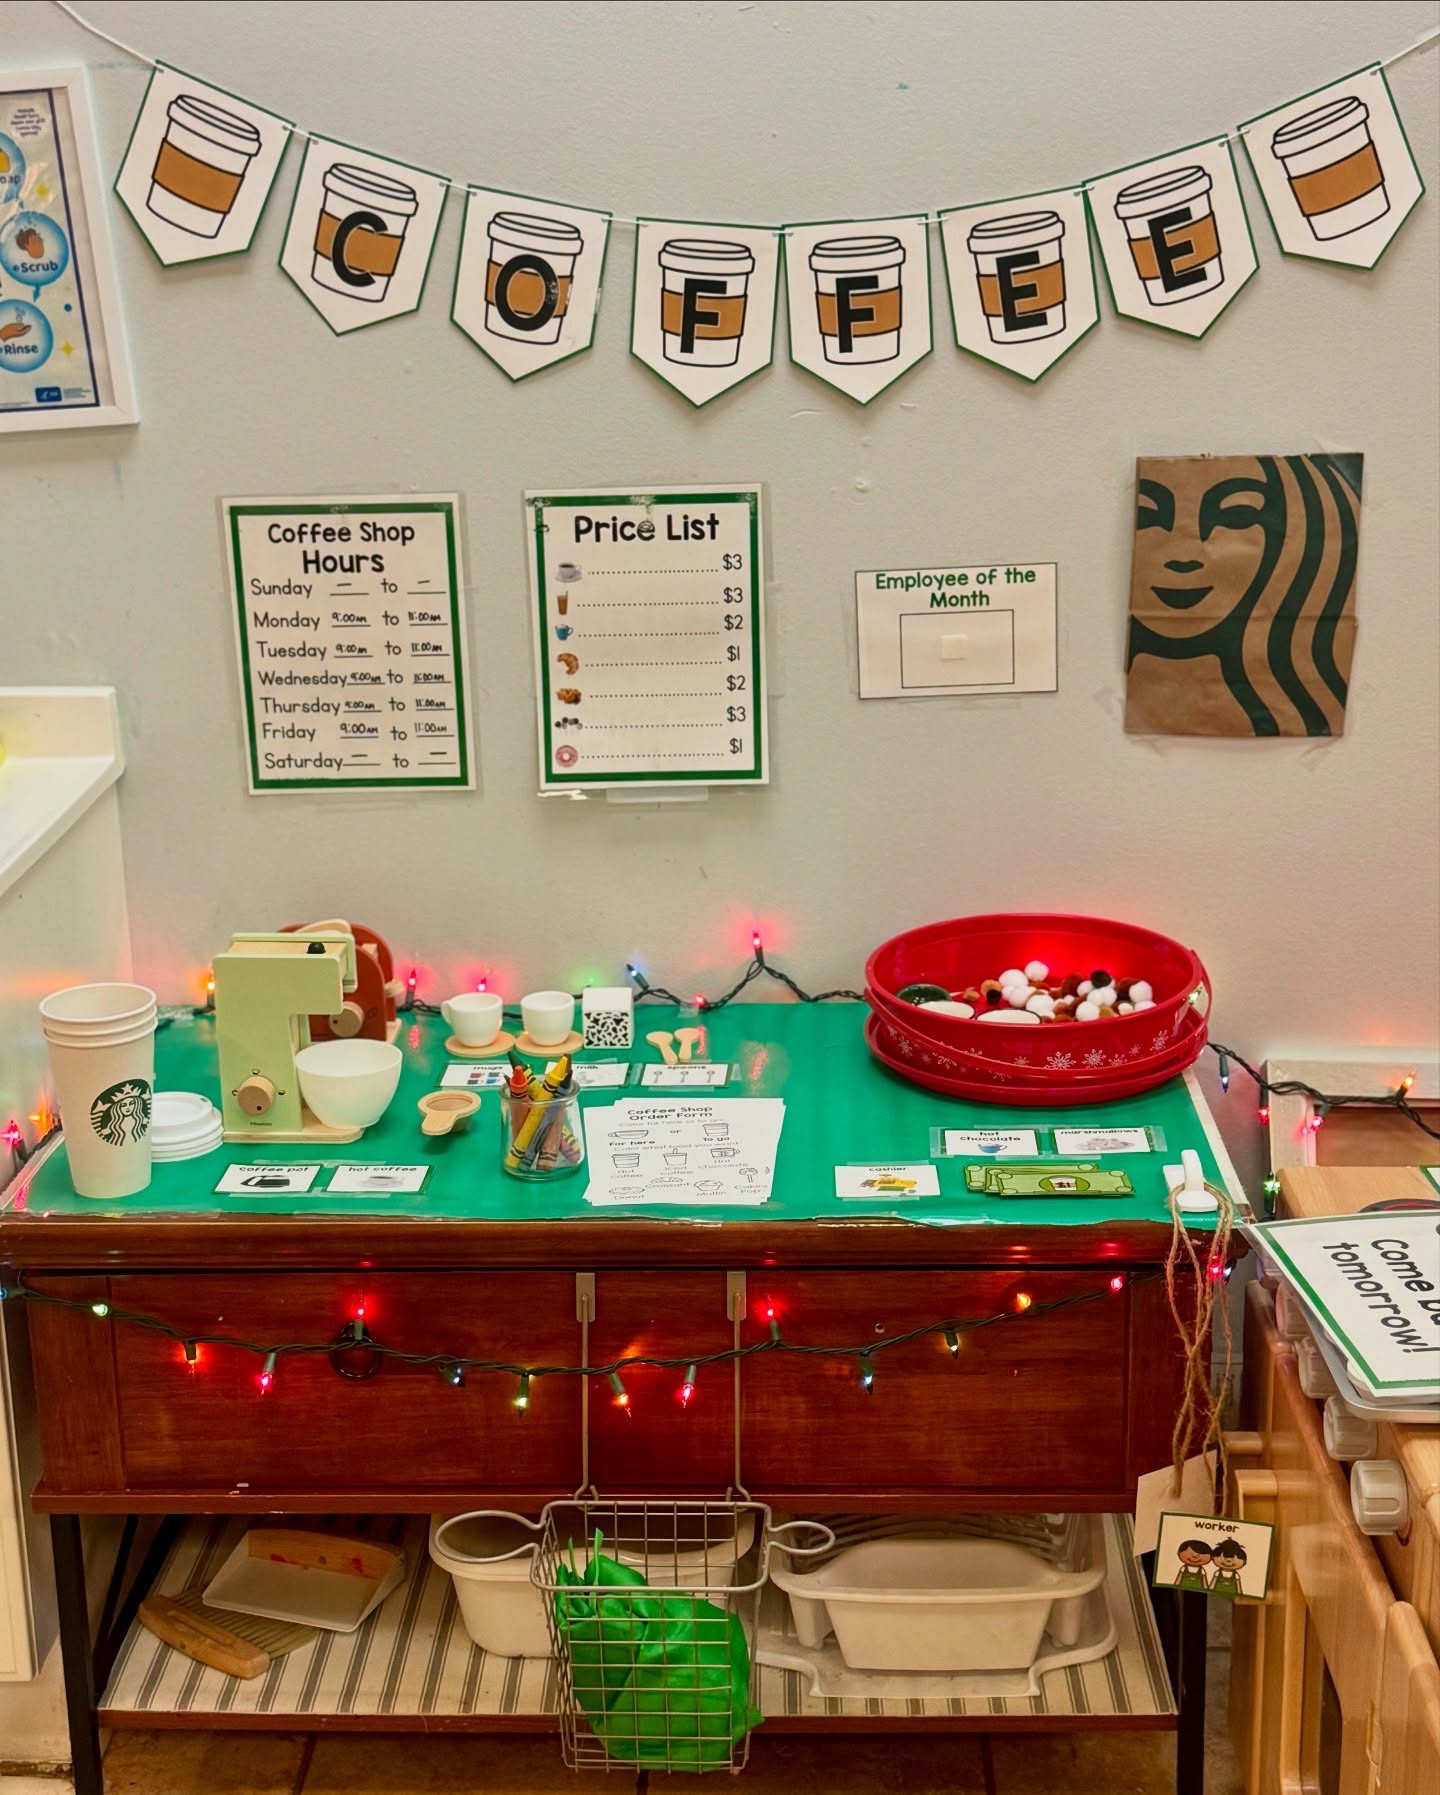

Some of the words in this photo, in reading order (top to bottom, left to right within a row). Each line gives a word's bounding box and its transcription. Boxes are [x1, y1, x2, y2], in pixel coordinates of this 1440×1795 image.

[20, 260, 59, 273] Scrub
[4, 344, 39, 355] Rinse
[267, 522, 352, 544] Coffee
[359, 521, 415, 546] Shop
[573, 515, 656, 543] Price
[666, 513, 720, 541] List
[302, 549, 385, 574] Hours
[722, 553, 743, 571] $3
[250, 578, 313, 599] Sunday
[381, 578, 398, 593] to
[875, 572, 969, 592] Employee
[976, 568, 998, 585] of
[1004, 567, 1036, 584] the
[723, 586, 744, 604] $3
[929, 590, 990, 608] Month
[253, 610, 321, 631] Monday
[382, 610, 400, 626] to
[723, 614, 744, 632] $2
[256, 641, 327, 661] Tuesday
[384, 640, 402, 656] to
[727, 645, 741, 662] $1
[258, 669, 347, 691] Wednesday
[386, 669, 404, 684] to
[726, 674, 746, 692] $2
[260, 696, 341, 716] Thursday
[388, 696, 406, 712] to
[726, 705, 747, 723] $3
[262, 722, 316, 742] Friday
[390, 725, 408, 741] to
[729, 737, 743, 755] $1
[265, 752, 344, 772] Saturday
[392, 753, 409, 769] to
[1370, 1238, 1436, 1293] Come
[1322, 1241, 1440, 1354] tomorrow!
[1194, 1521, 1240, 1533] worker
